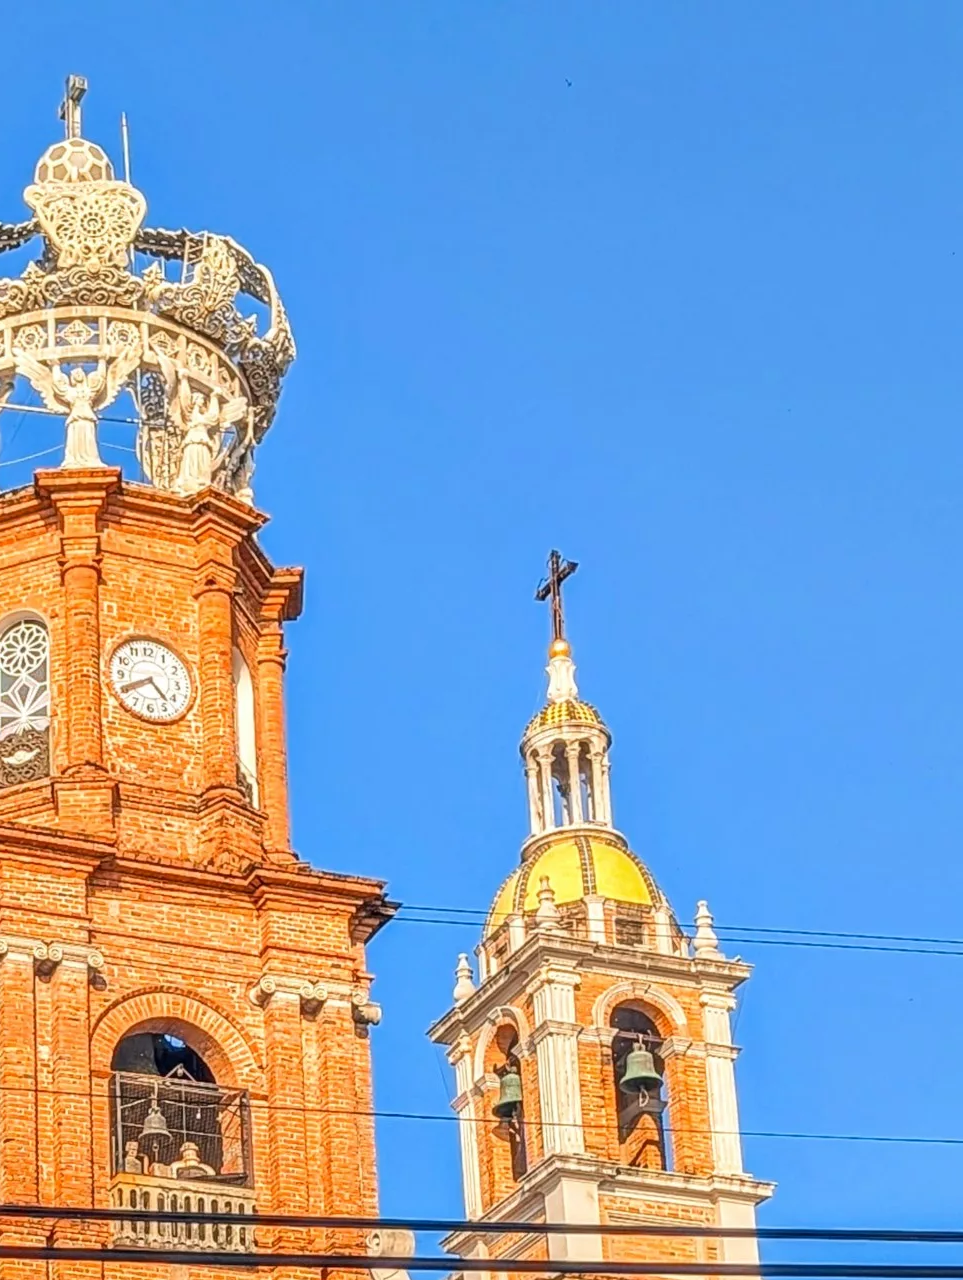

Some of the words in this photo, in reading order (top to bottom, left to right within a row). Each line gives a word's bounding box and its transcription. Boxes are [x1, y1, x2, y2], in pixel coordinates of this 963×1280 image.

[130, 647, 138, 656] 11
[143, 647, 153, 657] 12
[119, 656, 130, 665] 10
[161, 655, 165, 663] 1
[117, 670, 124, 679] 9
[171, 666, 178, 675] 2
[174, 681, 180, 691] 3
[132, 697, 139, 706] 7
[169, 694, 176, 702] 4
[147, 704, 154, 713] 6
[162, 703, 167, 712] 5
